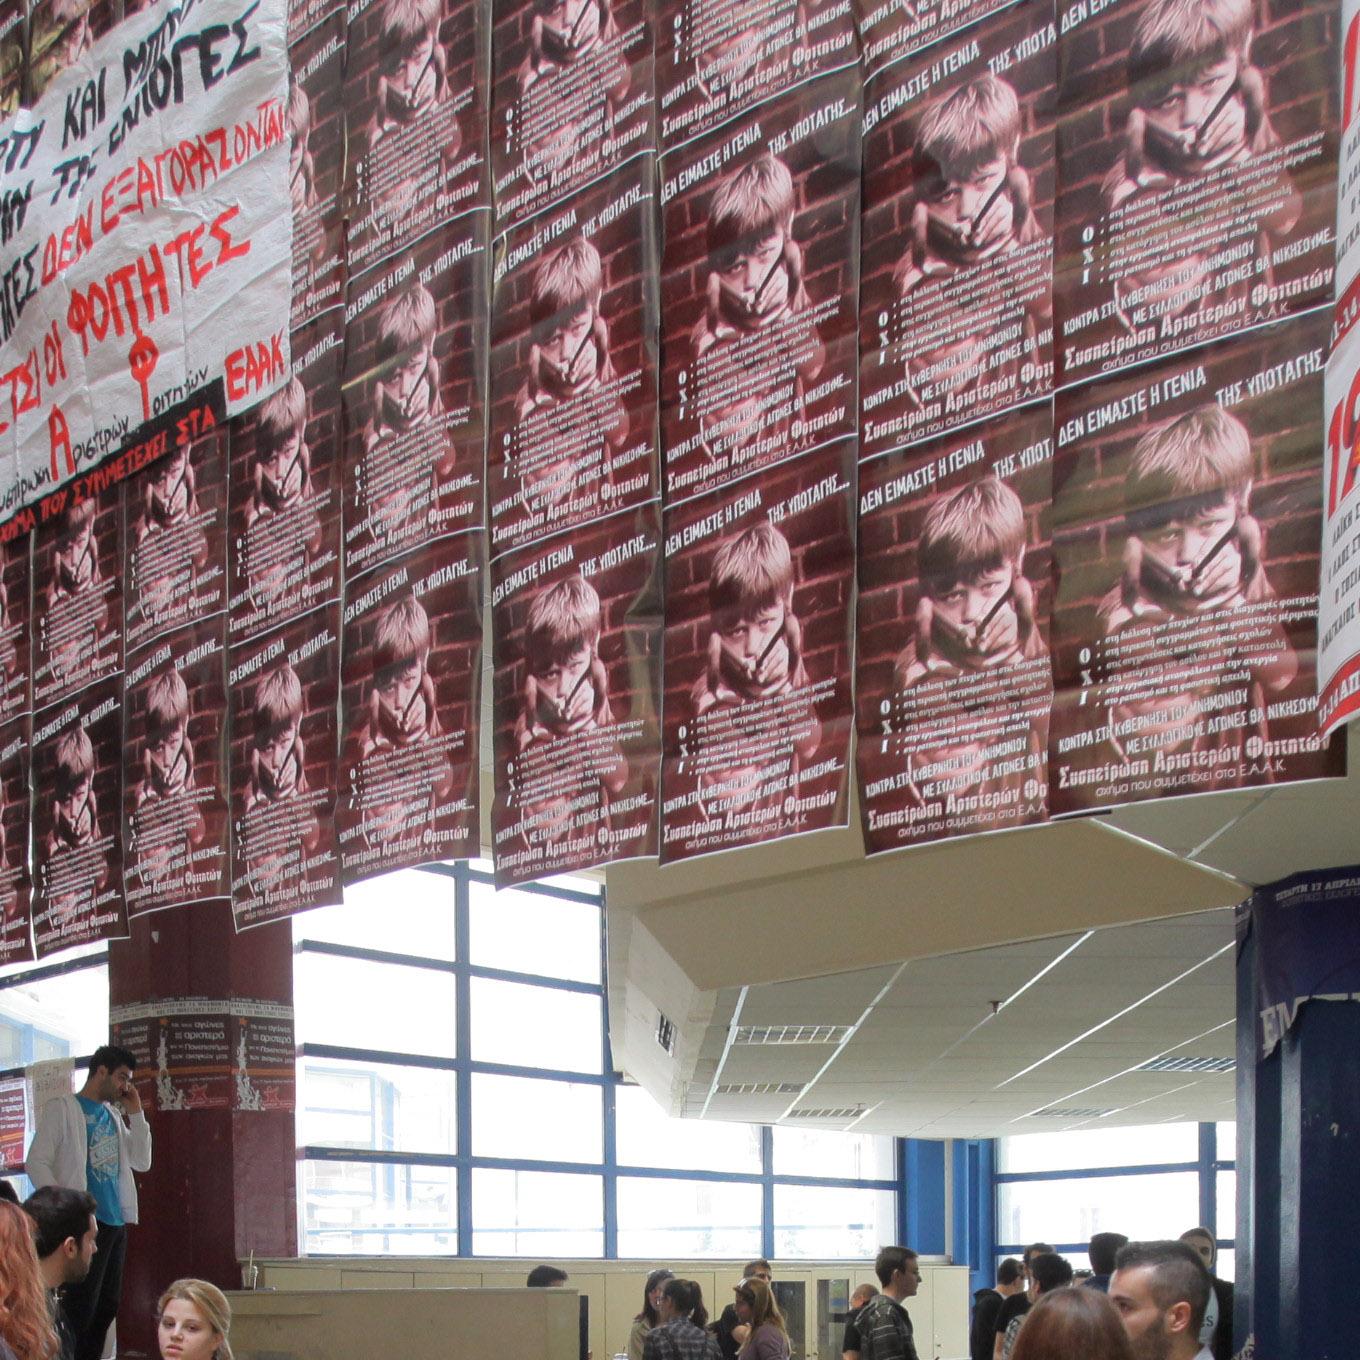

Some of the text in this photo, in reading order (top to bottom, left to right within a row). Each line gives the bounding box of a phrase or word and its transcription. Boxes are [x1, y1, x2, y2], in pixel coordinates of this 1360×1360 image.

[61, 67, 106, 150] ΚΑΙ
[41, 199, 94, 287] ΔΕΝ
[44, 319, 67, 387] ΟΙ
[67, 206, 251, 357] ΦΟΙΤΗΤΕΣ
[224, 327, 285, 402] ΕΑΑΚ
[1058, 420, 1085, 447] ΔΕΝ
[1087, 389, 1147, 433] ΕΙΜΑΣΤΕ
[1150, 386, 1161, 407] Η
[1163, 365, 1207, 400] ΓΕΝΙΑ
[1215, 382, 1244, 410] ΤΗΣ
[40, 491, 69, 520] ΠΟΥ
[175, 404, 216, 446] ΣΤΑ
[860, 487, 883, 515] ΔΕΝ
[885, 462, 937, 503] ΕΙΜΑΣΤΕ
[938, 459, 947, 478] Η
[949, 439, 985, 473] ΓΕΝΙΑ
[993, 451, 1018, 481] ΤΗΣ
[665, 532, 682, 558] ΔΕΝ
[683, 508, 724, 547] ΕΙΜΑΣΤΕ
[725, 506, 733, 524] Η
[734, 488, 762, 520] ΓΕΝΙΑ
[767, 501, 787, 526] ΤΗΣ
[1059, 732, 1093, 753] ΚΟΝΤΡΑ
[1189, 688, 1248, 716] ΜΝΗΜΟΝΙΟΥ
[1126, 740, 1140, 755] ΜΕ
[1207, 712, 1247, 735] ΑΓΩΝΕΣ
[1249, 707, 1265, 723] ΘΑ
[1059, 752, 1149, 789] Συσπείρωση
[1154, 744, 1240, 774] Αριστερών
[1311, 882, 1322, 891] 17
